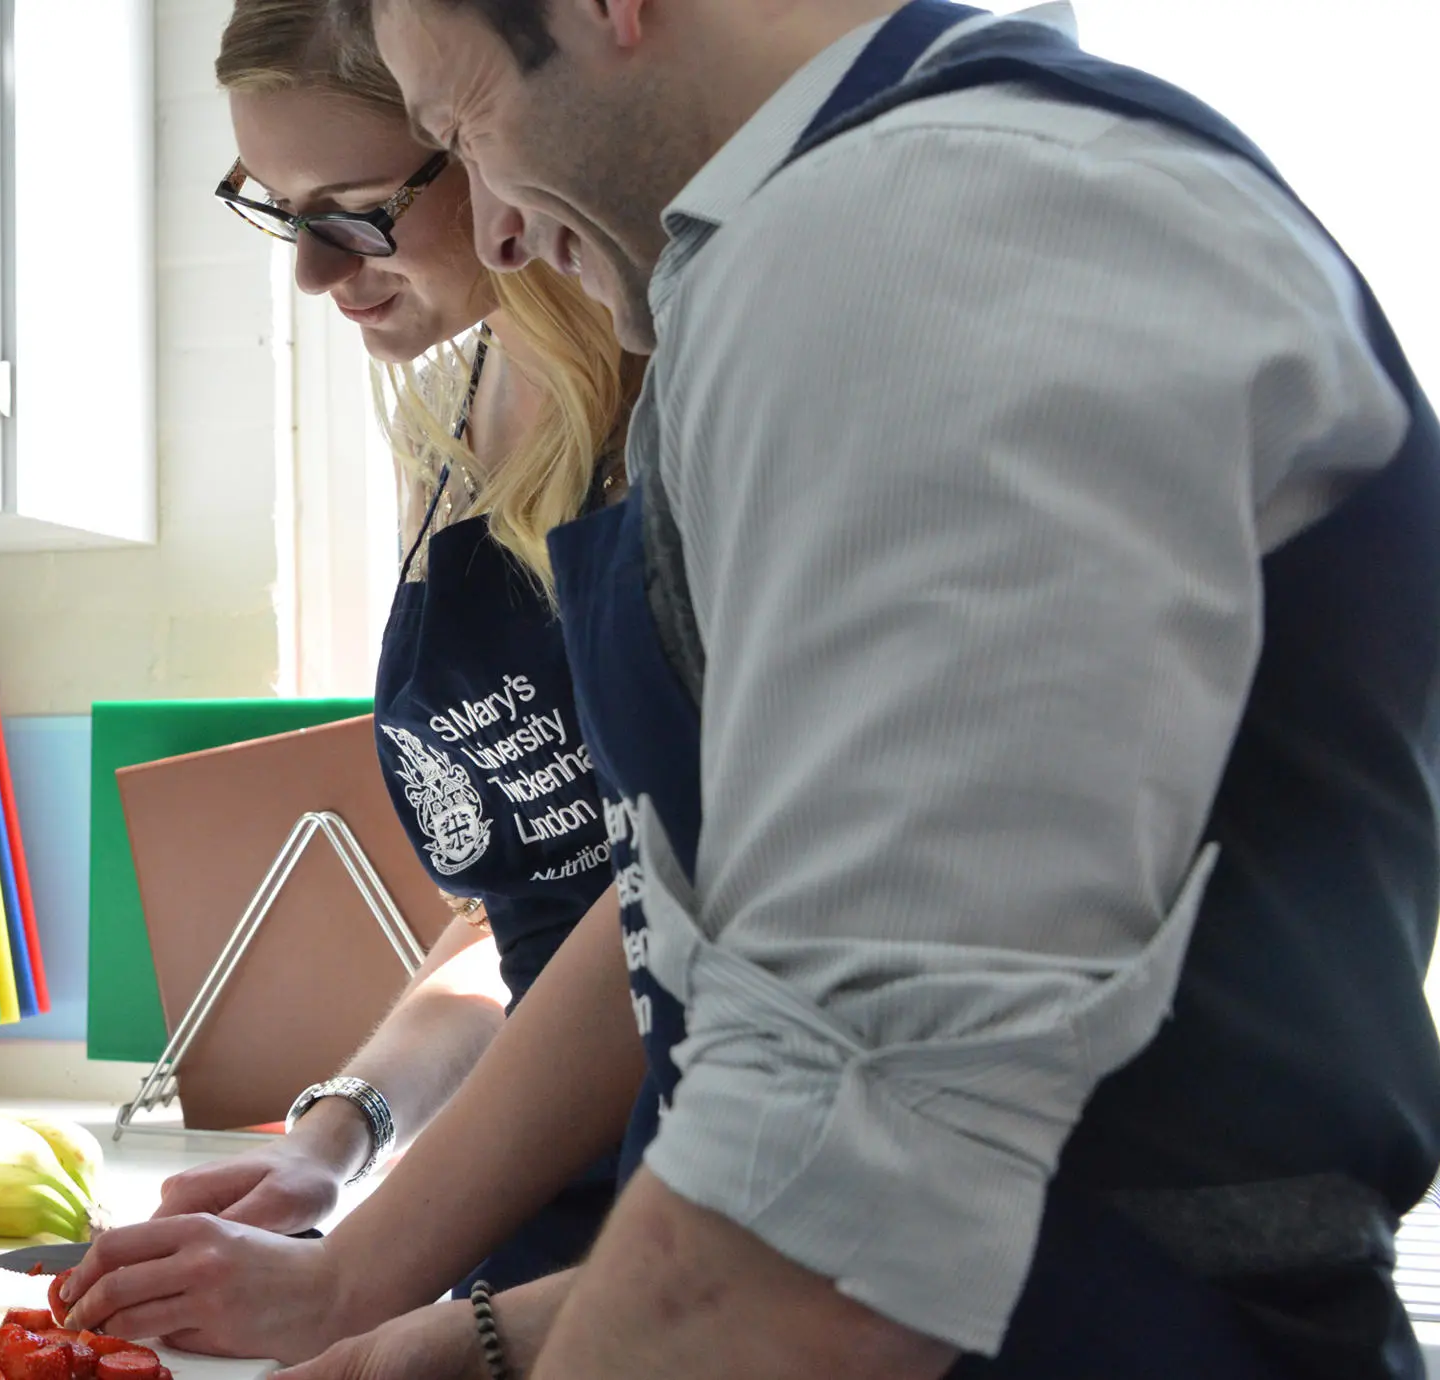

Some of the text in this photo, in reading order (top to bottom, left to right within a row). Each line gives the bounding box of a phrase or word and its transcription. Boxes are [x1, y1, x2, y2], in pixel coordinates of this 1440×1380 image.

[448, 674, 536, 736] Mary's
[460, 708, 566, 769] Uiversity
[487, 744, 594, 803] Tickenha
[514, 799, 597, 844] Lndon
